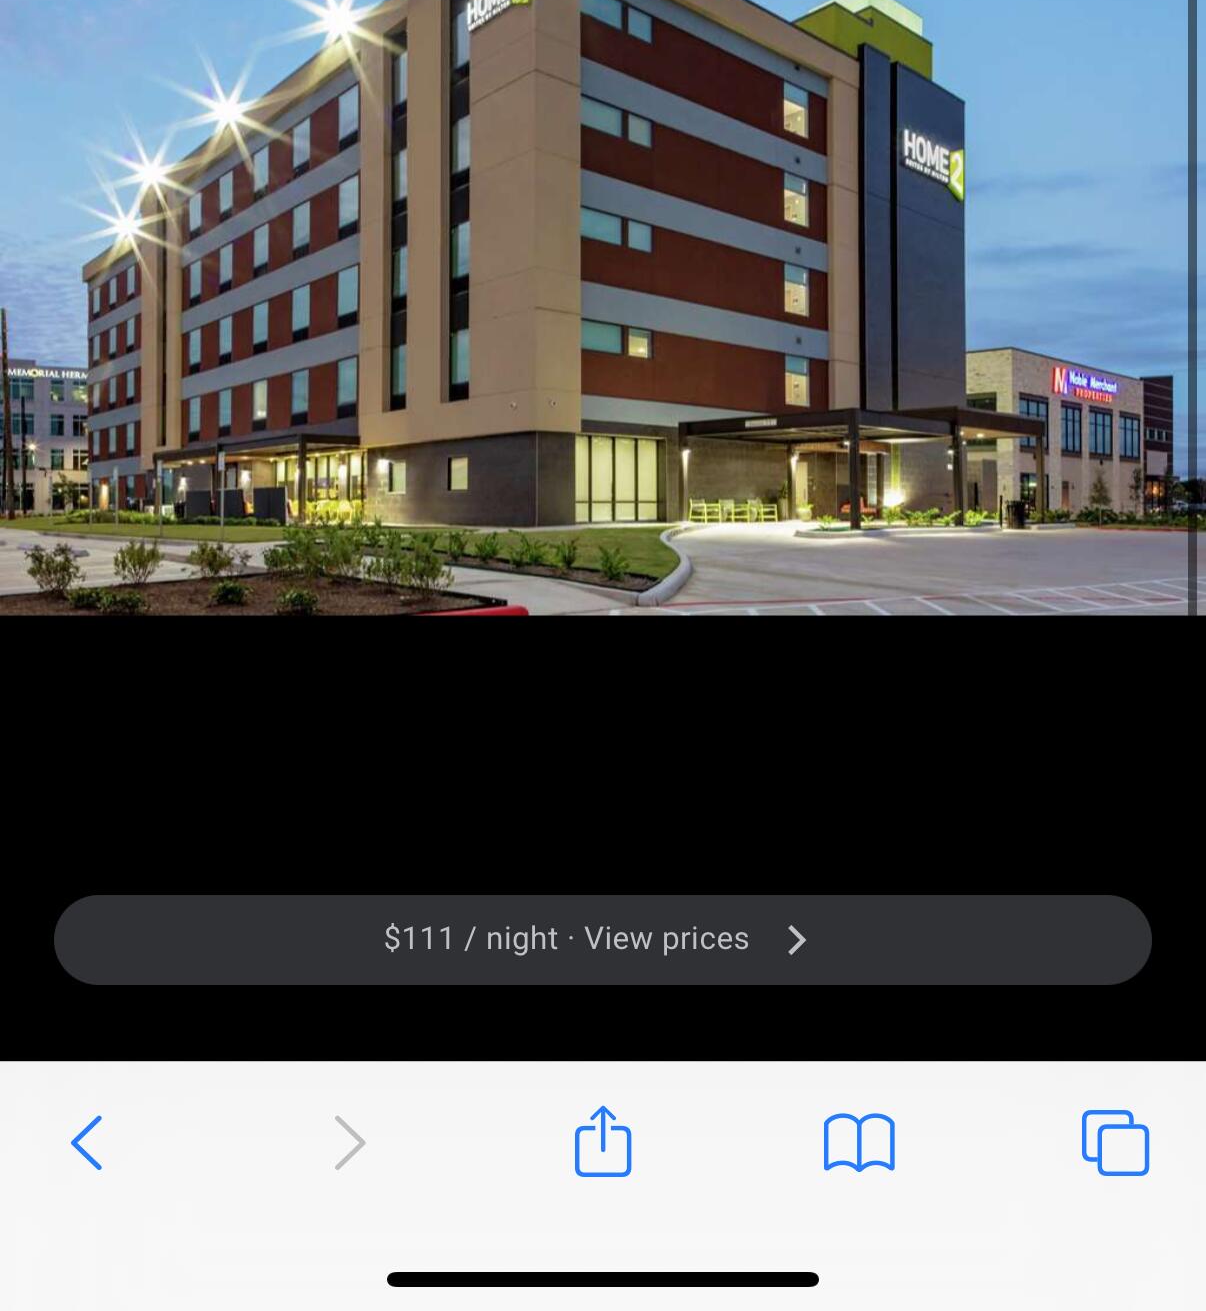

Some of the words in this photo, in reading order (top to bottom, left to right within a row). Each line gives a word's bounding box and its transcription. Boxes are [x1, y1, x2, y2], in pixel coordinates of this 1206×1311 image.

[8, 369, 60, 379] MEMORIAL
[384, 922, 451, 953] $111
[487, 924, 558, 957] night
[584, 925, 653, 950] View
[663, 925, 749, 957] prices
